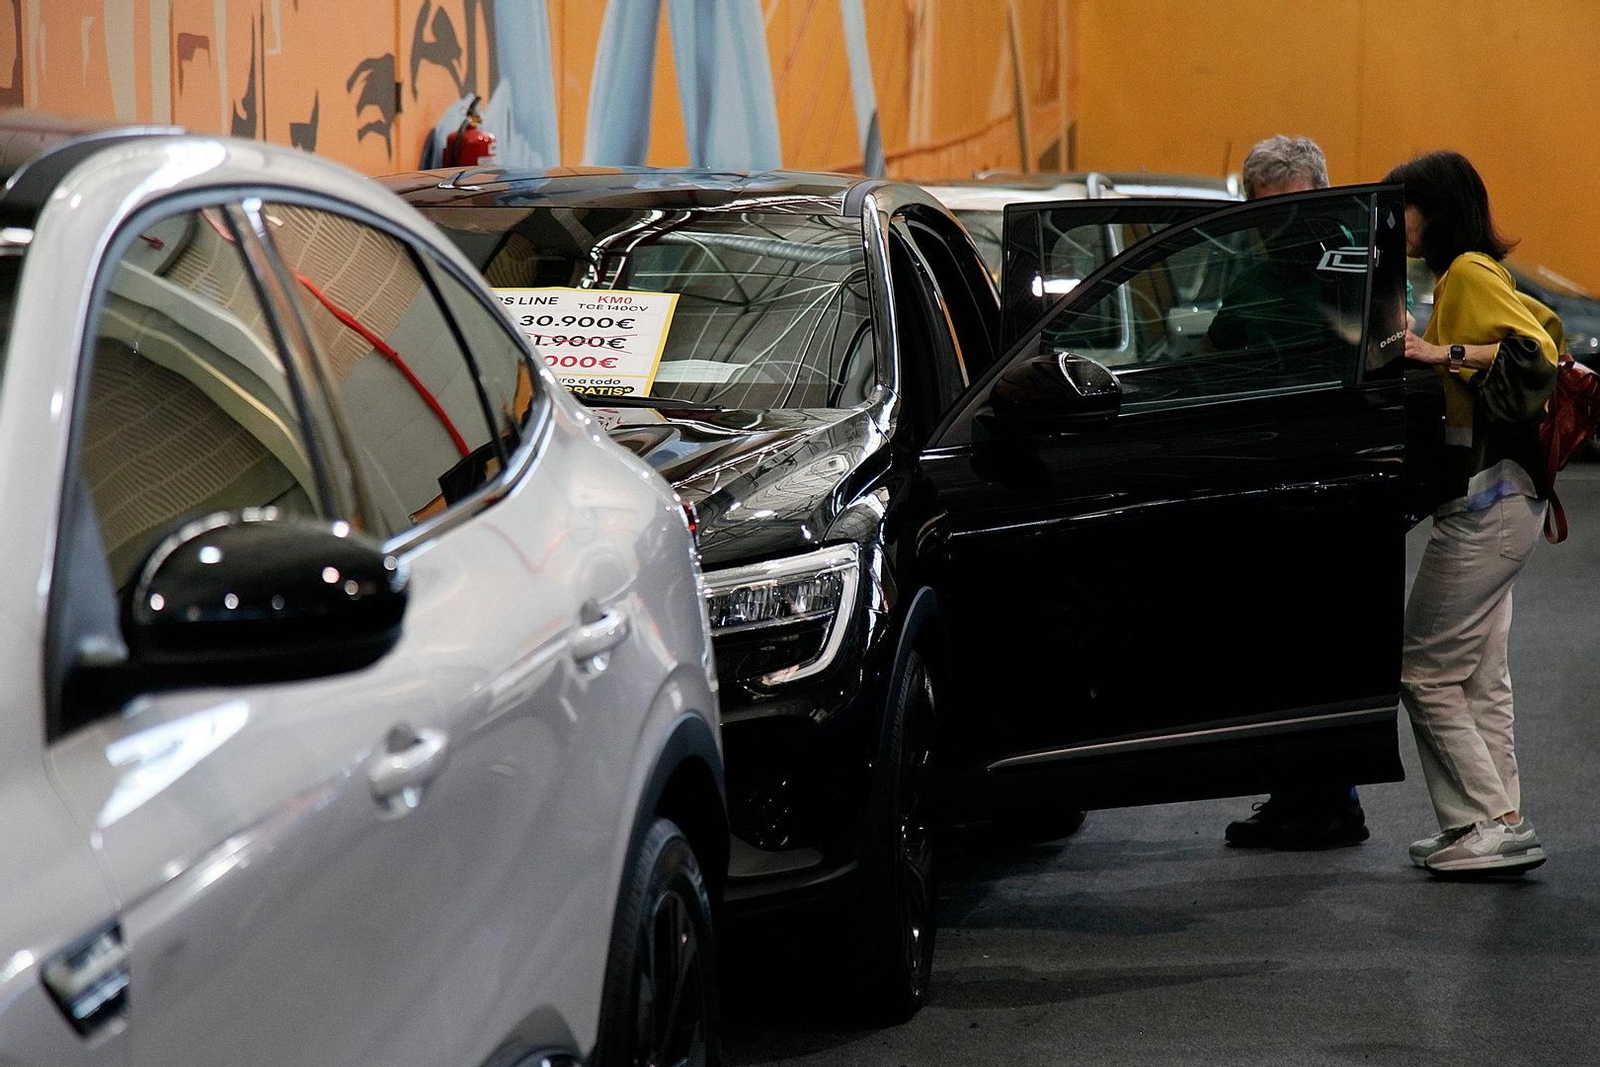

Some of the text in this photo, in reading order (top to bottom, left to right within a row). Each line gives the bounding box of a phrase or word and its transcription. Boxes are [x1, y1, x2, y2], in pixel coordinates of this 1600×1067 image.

[518, 296, 559, 305] LINE
[519, 315, 636, 329] 30.900€
[527, 335, 627, 349] 1.900€
